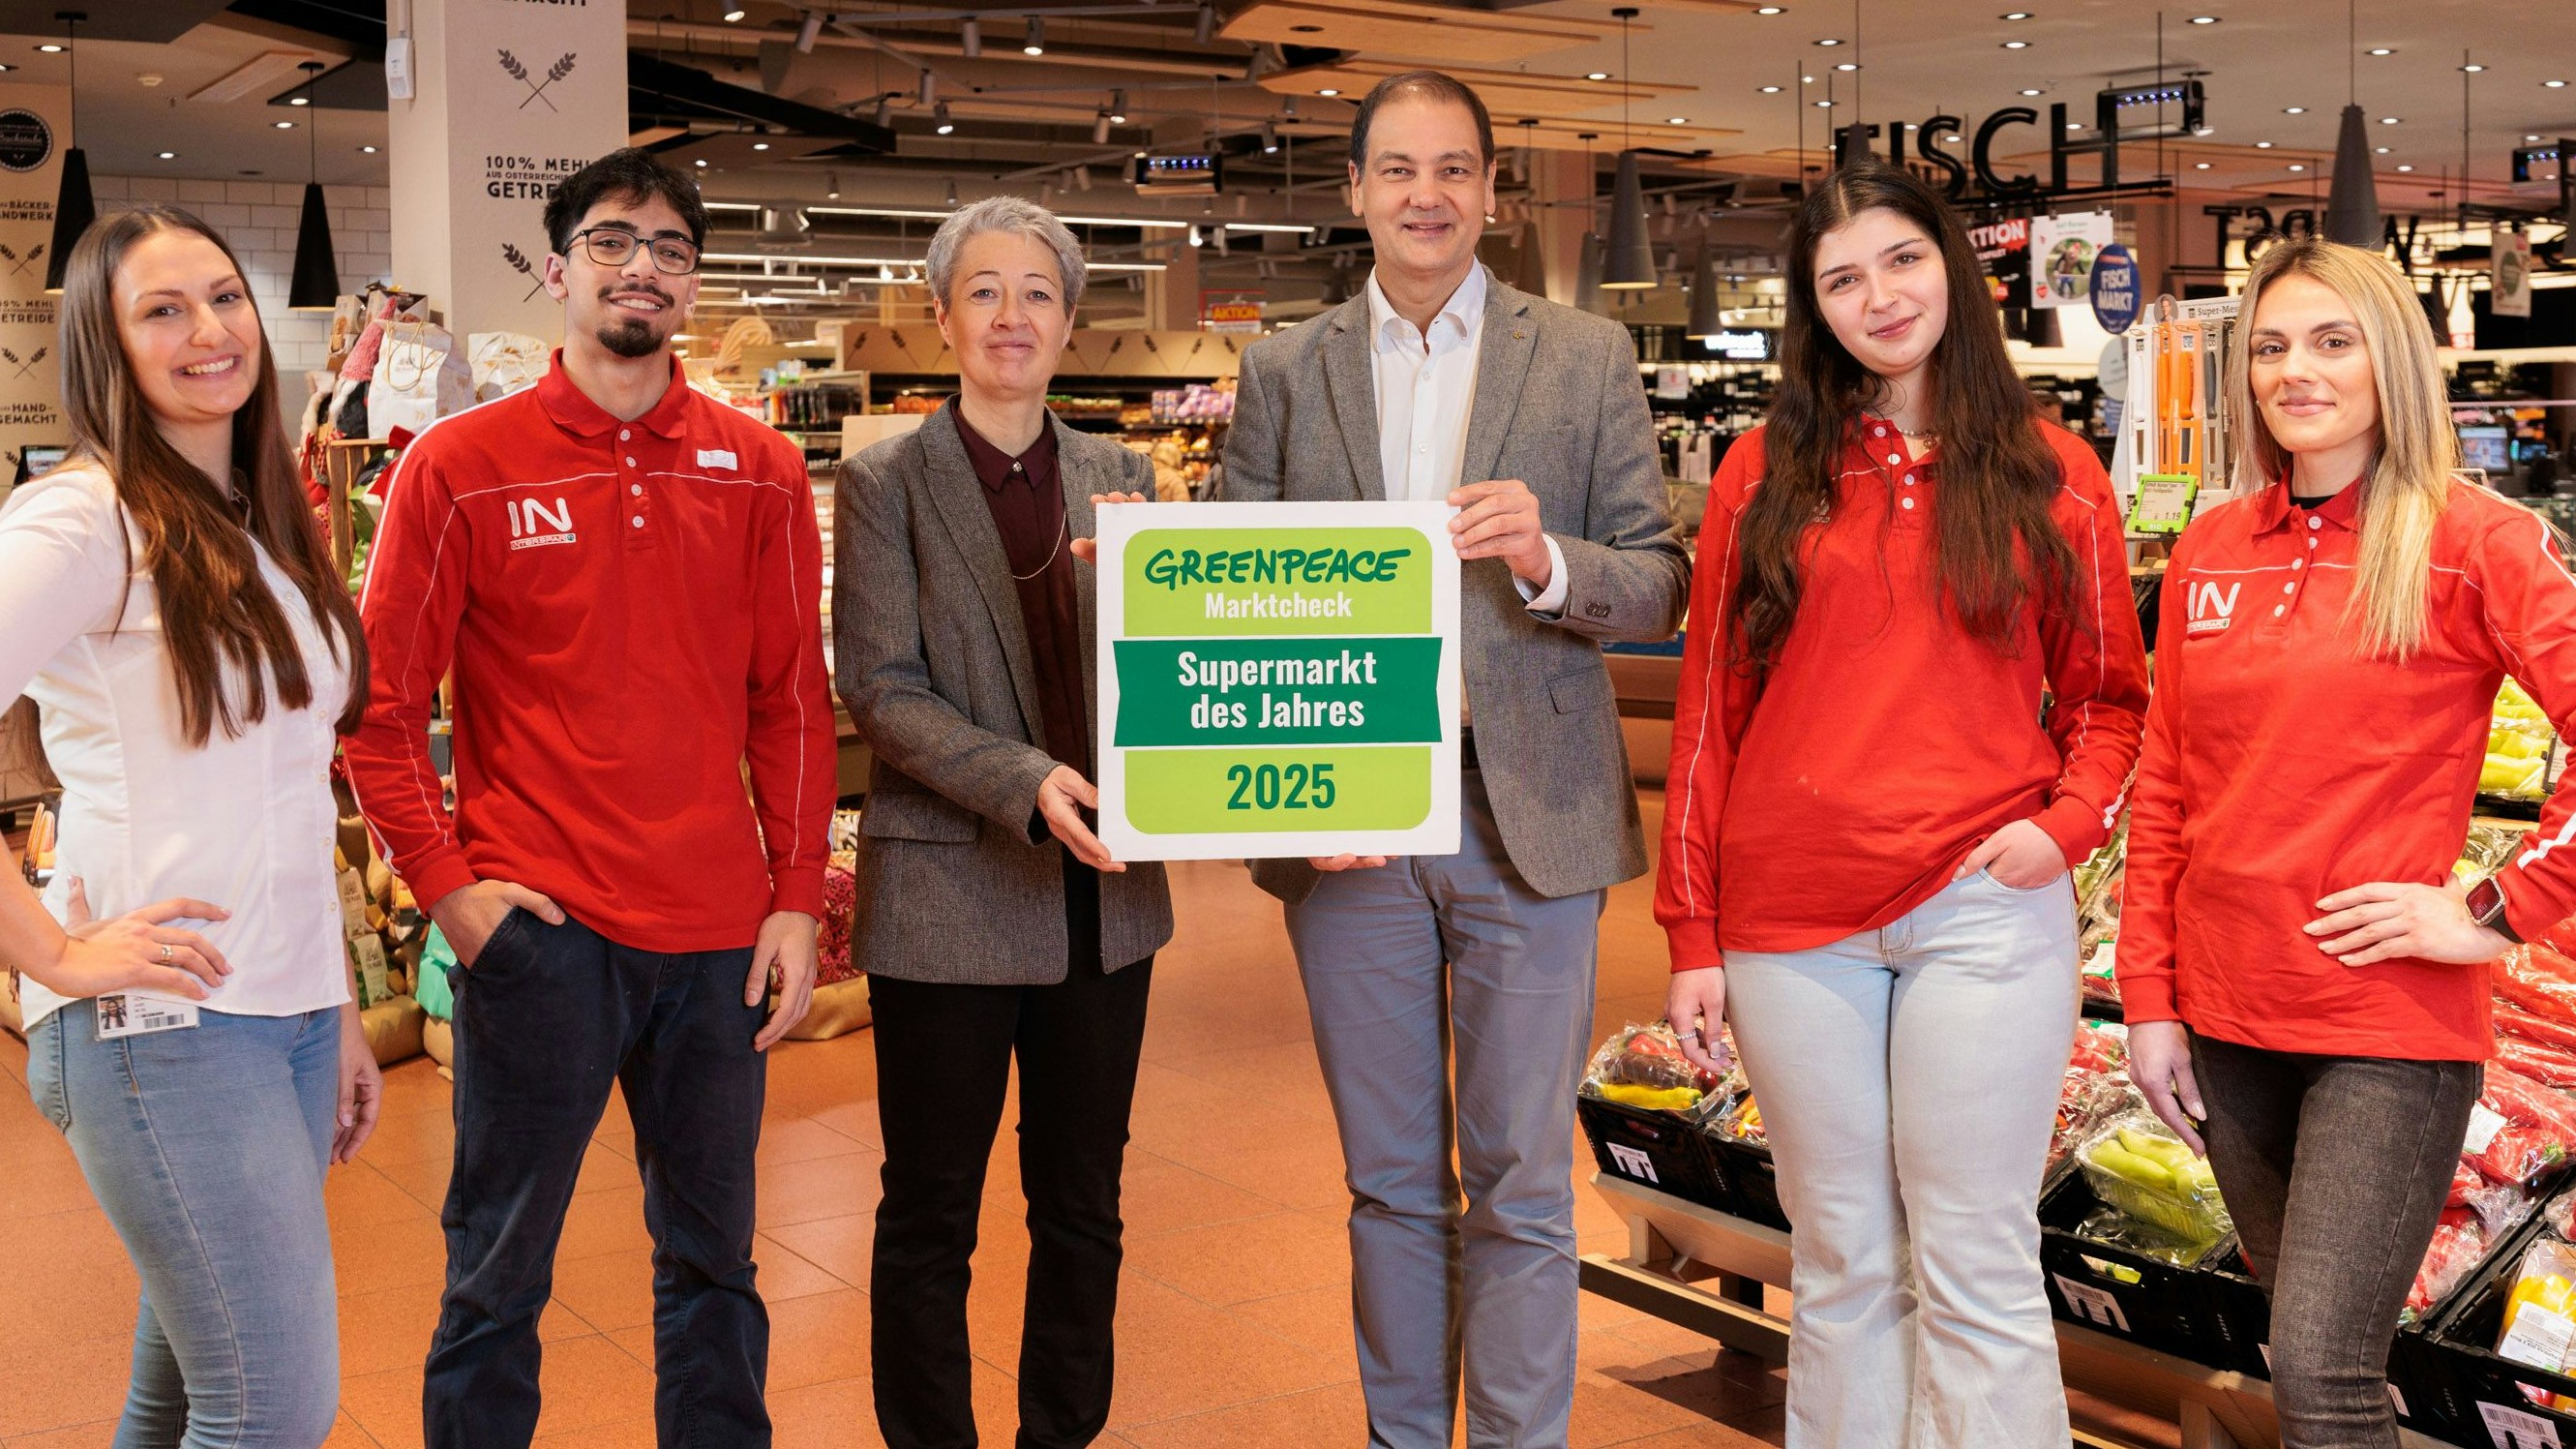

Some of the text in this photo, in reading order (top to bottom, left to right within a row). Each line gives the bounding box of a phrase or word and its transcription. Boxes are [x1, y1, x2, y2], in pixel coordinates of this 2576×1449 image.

[486, 156, 535, 170] 100%
[487, 181, 558, 199] GETRE
[0, 211, 53, 221] NDWERK
[2101, 267, 2131, 290] FISCH
[2097, 289, 2134, 311] MARKT
[2198, 305, 2238, 317] Super-Mes
[2, 314, 55, 324] ETREIDE
[507, 497, 573, 538] IN
[1145, 548, 1411, 590] GREENPEACE
[1205, 591, 1353, 619] Marktcheck
[2188, 581, 2241, 620] IN
[1178, 649, 1377, 693] Supermarkt
[1190, 692, 1365, 728] des Jahres
[1227, 764, 1336, 810] 2025
